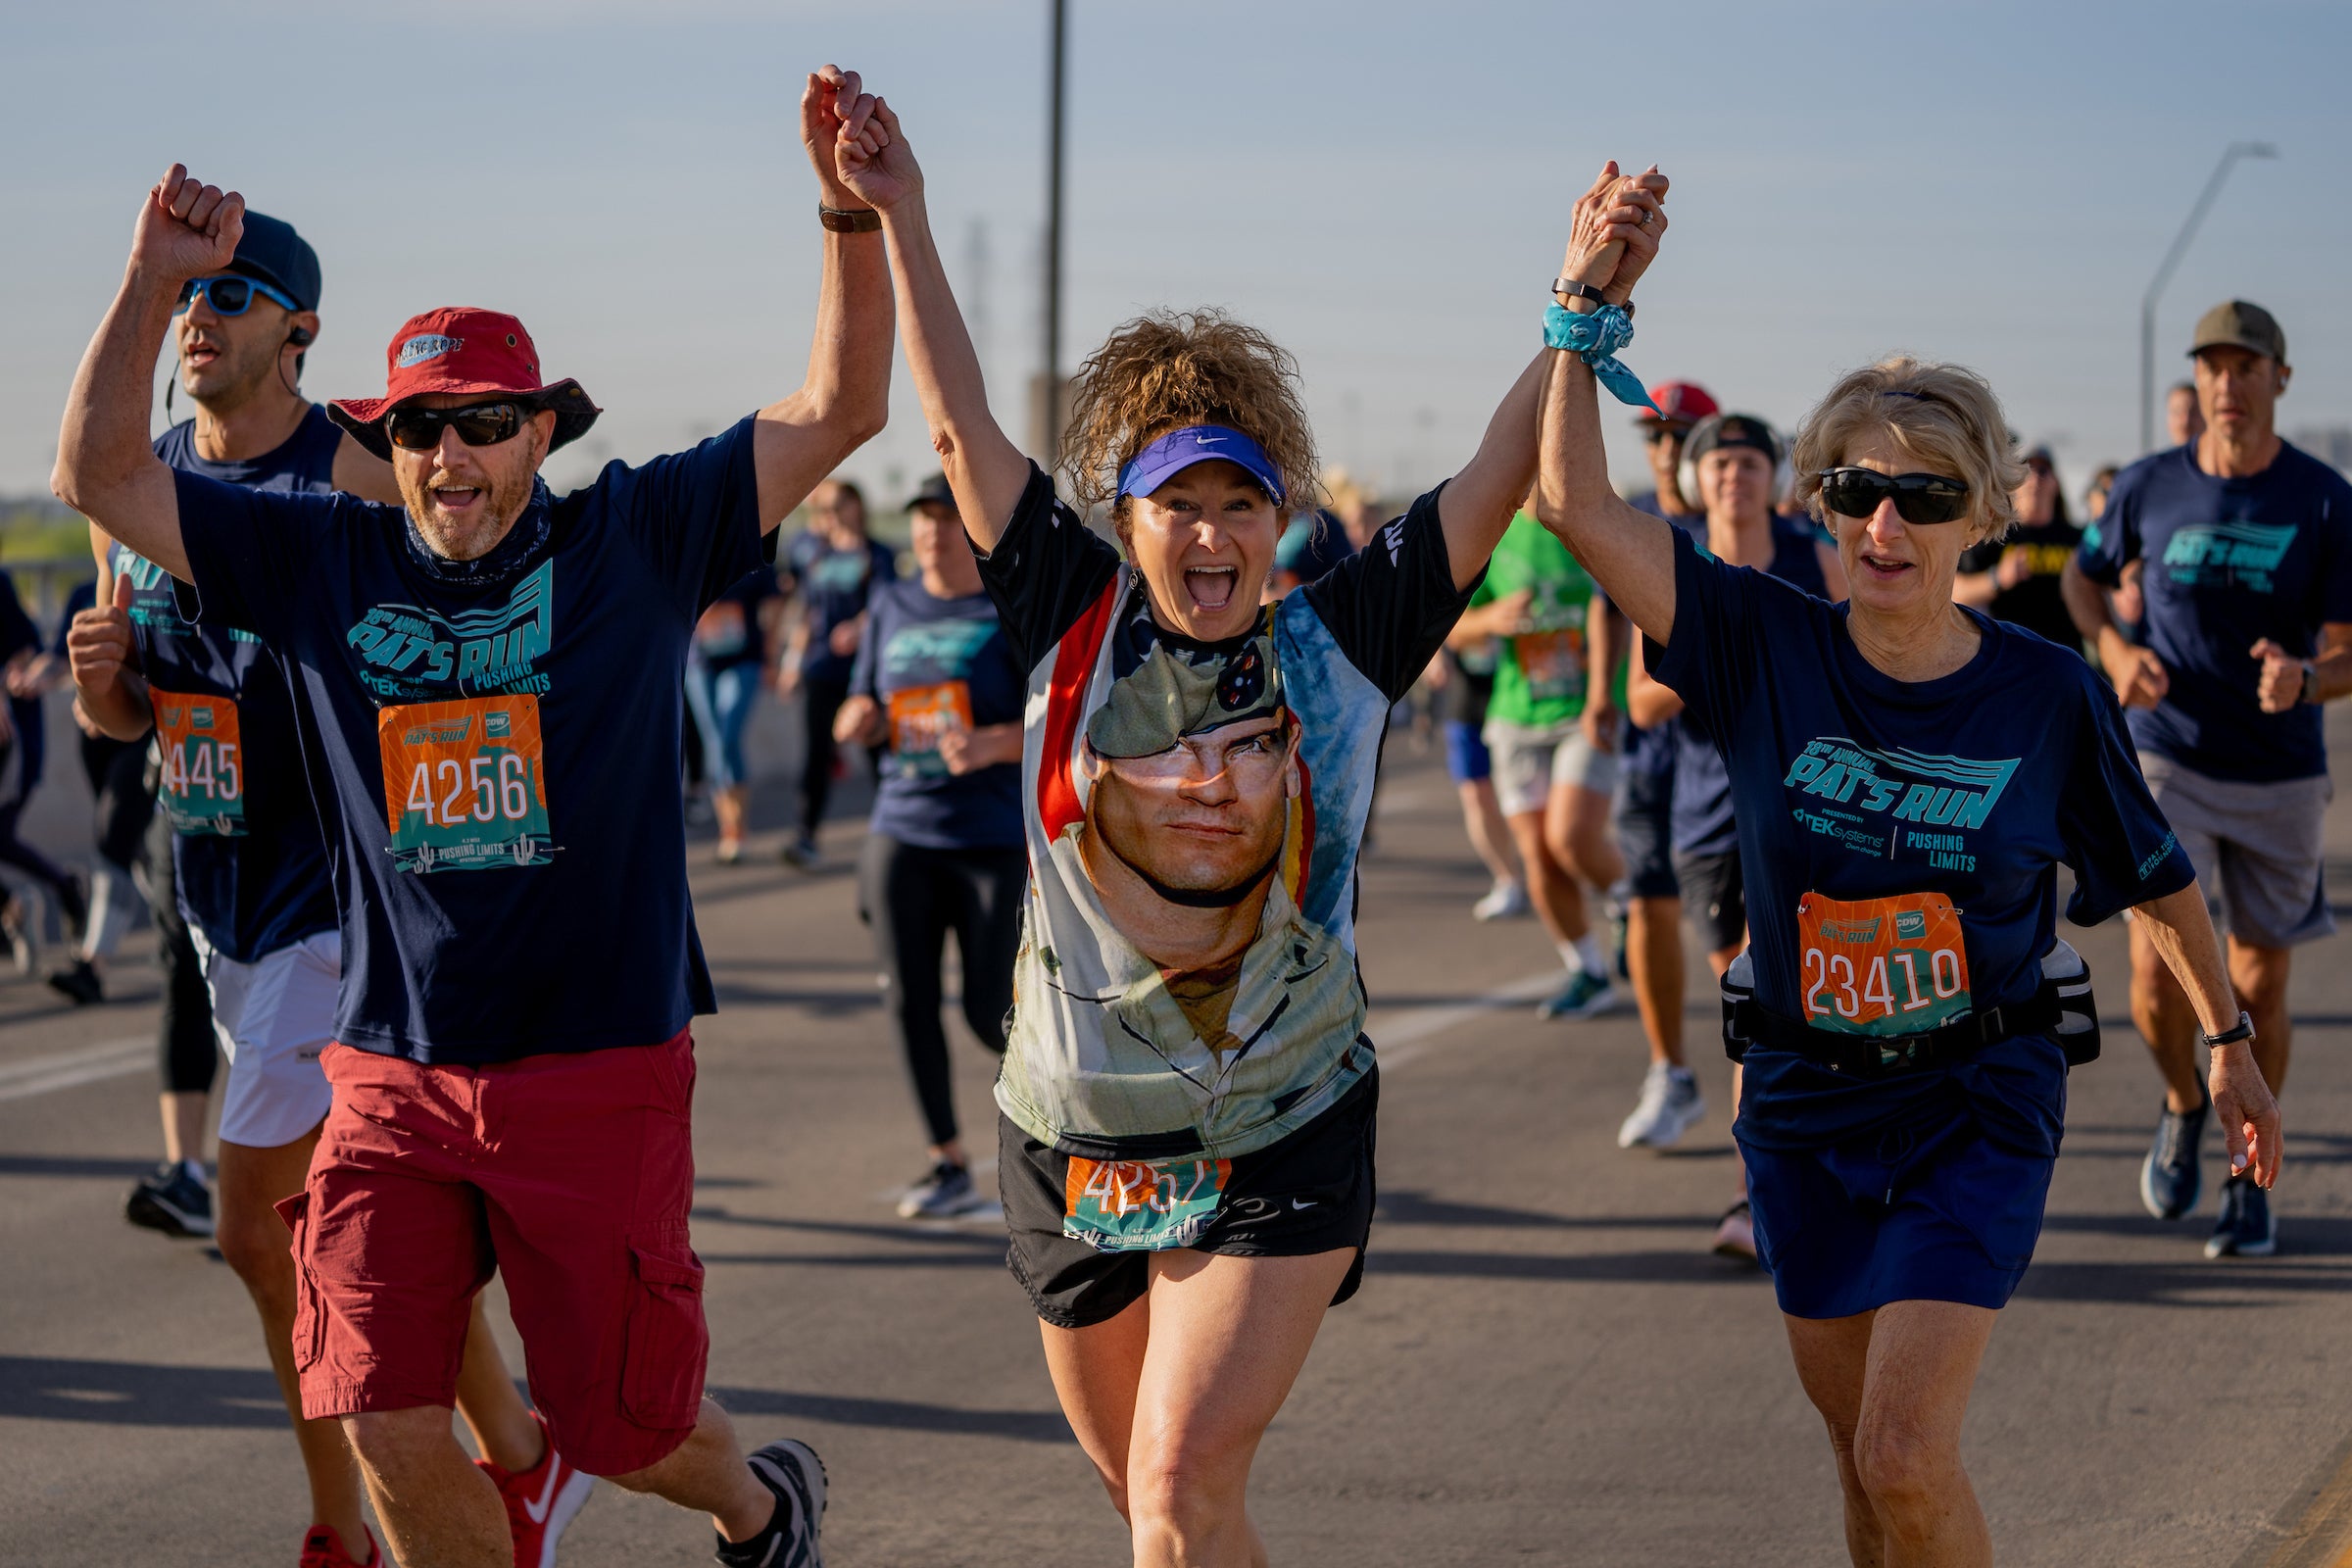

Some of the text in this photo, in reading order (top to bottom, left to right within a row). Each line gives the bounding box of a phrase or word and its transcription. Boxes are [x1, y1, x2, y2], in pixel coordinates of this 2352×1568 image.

[347, 590, 553, 681] PATS RUN
[389, 614, 434, 641] ANNUA
[473, 662, 534, 692] PUSHING
[502, 673, 552, 695] LIMITS
[404, 729, 438, 746] PAT'S
[439, 723, 471, 743] RUN
[1803, 741, 1877, 773] 18TH ANNUAL
[407, 754, 527, 825] 4256
[1784, 754, 2018, 829] PAT'S RUN
[1822, 808, 1856, 822] PRESENTED
[438, 844, 475, 860] PUSHING
[476, 843, 505, 857] LIMITS
[1907, 831, 1964, 852] PUSHING
[1929, 850, 1976, 872] LIMITS
[1846, 921, 1881, 943] RUN
[1896, 916, 1920, 928] CDW
[1805, 948, 1961, 1017] 23410
[1084, 1161, 1204, 1212] 4257
[1104, 1234, 1144, 1245] PUSHING
